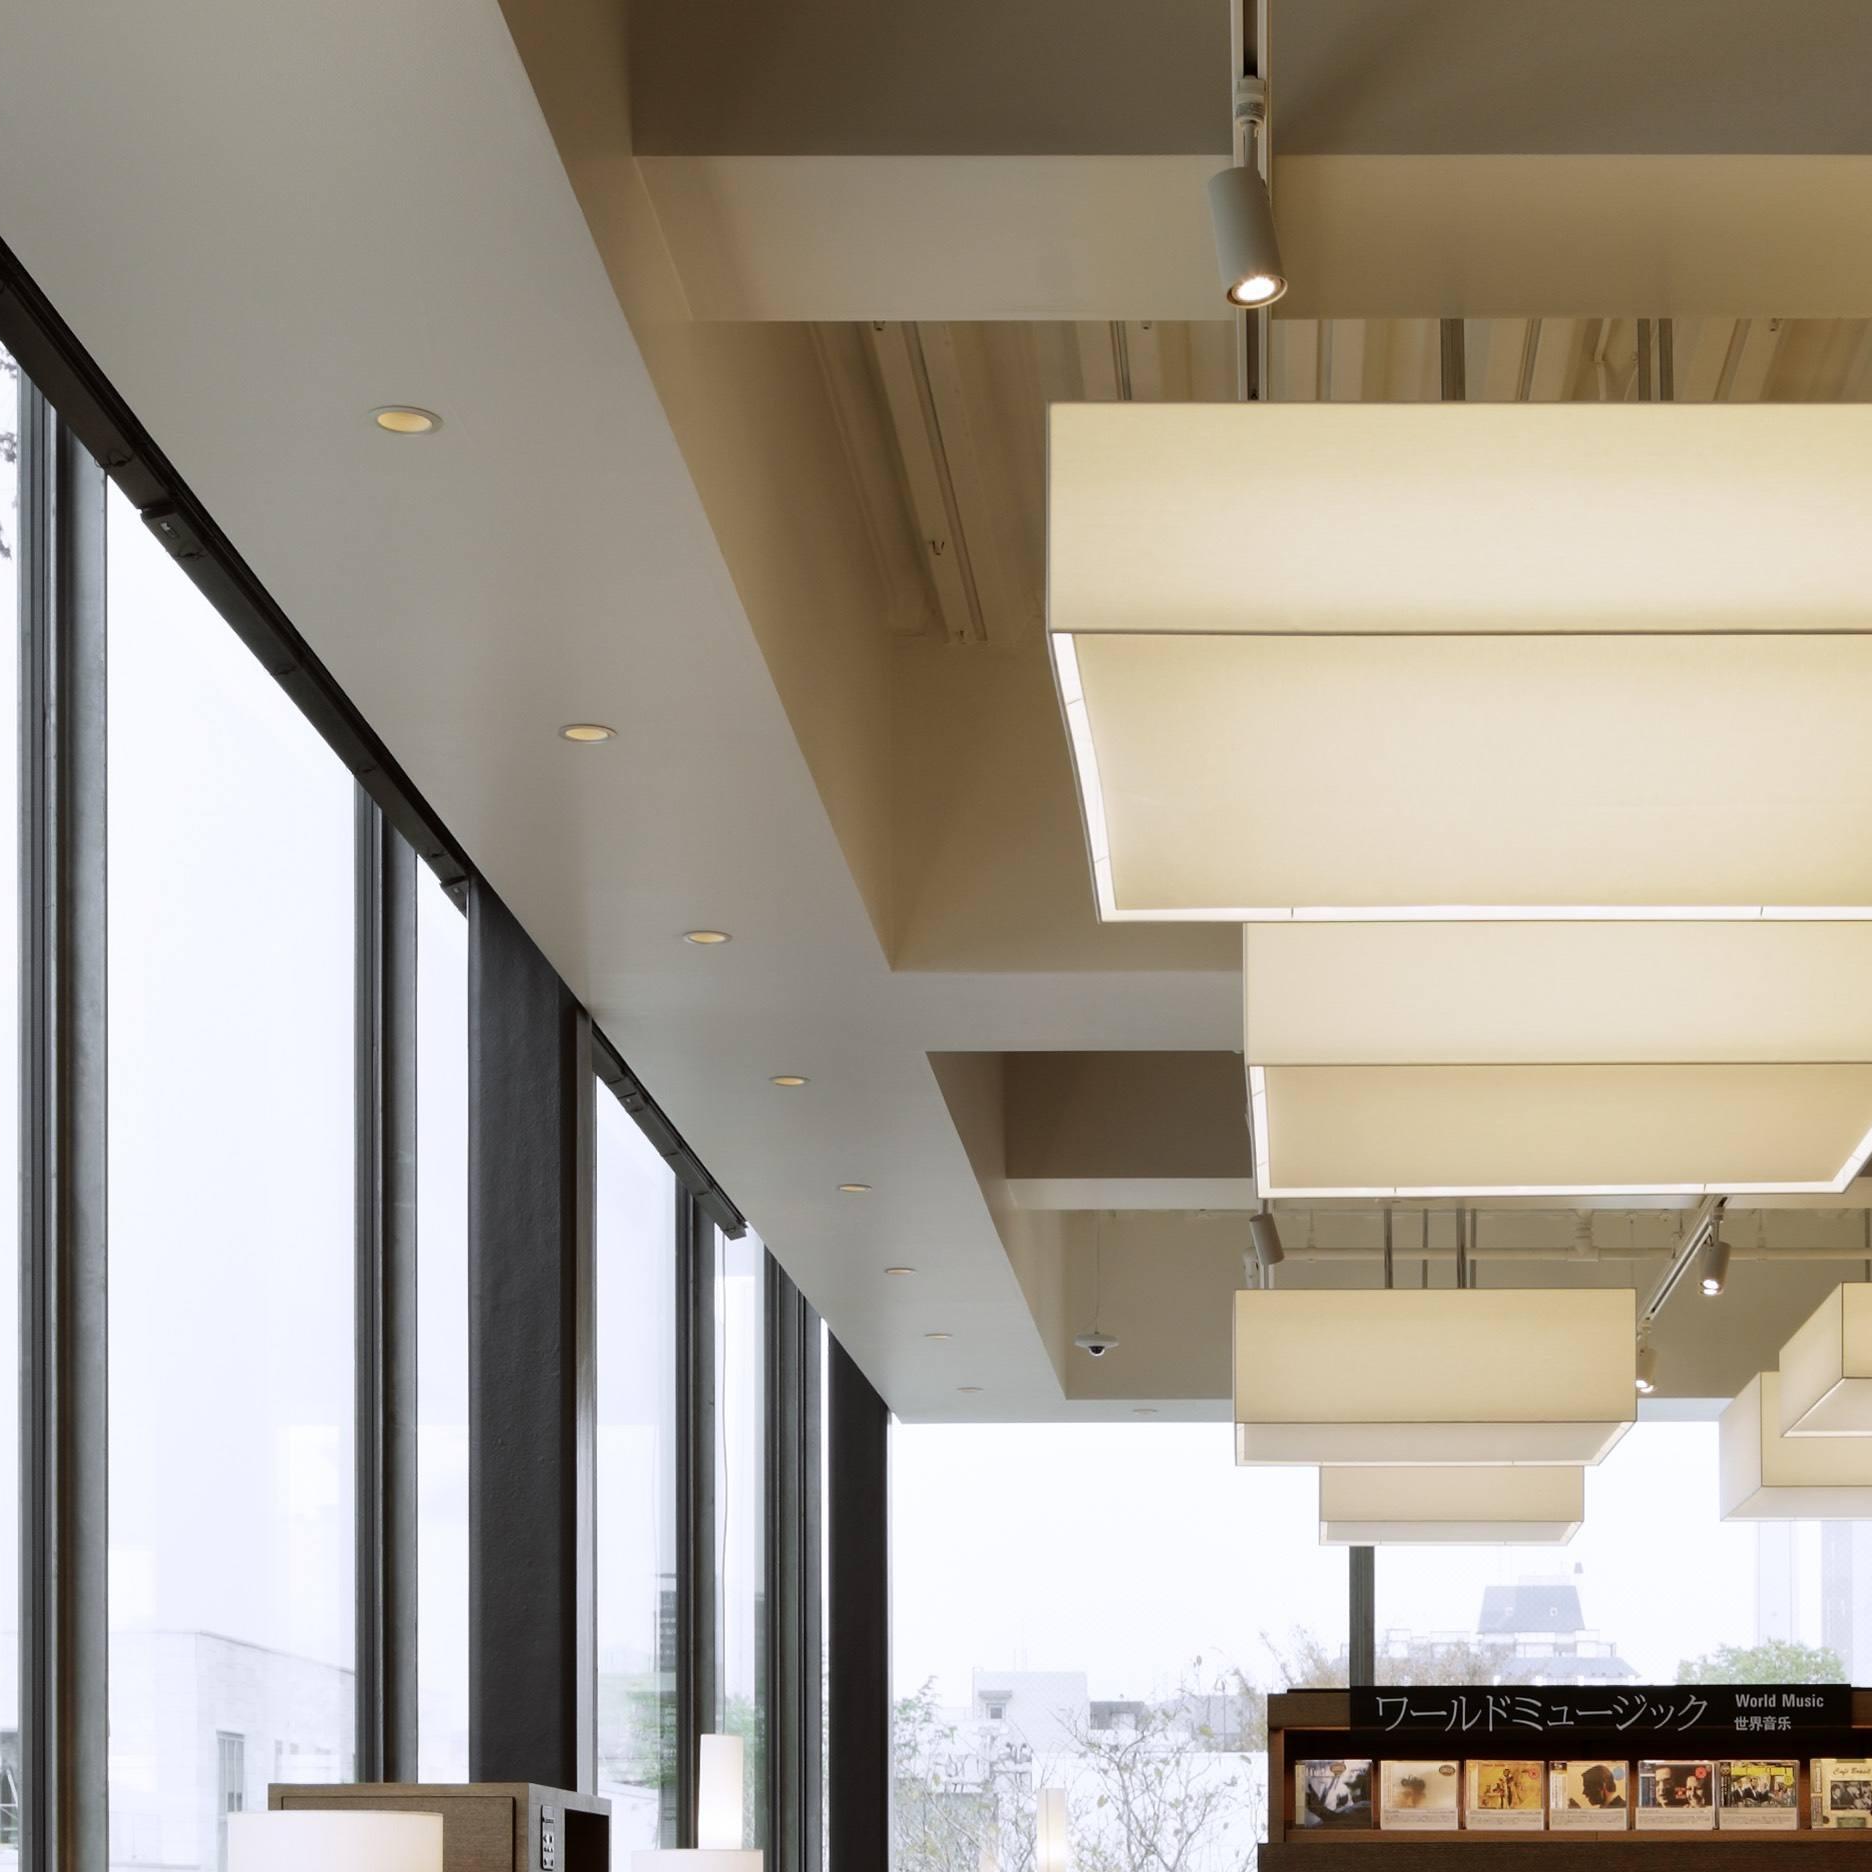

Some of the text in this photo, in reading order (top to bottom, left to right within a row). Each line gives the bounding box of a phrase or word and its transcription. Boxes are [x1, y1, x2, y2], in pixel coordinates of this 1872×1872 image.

[1735, 1693, 1825, 1708] World Music
[1376, 1694, 1708, 1733] ワールドミュージック
[1734, 1716, 1792, 1731] 世界音乐
